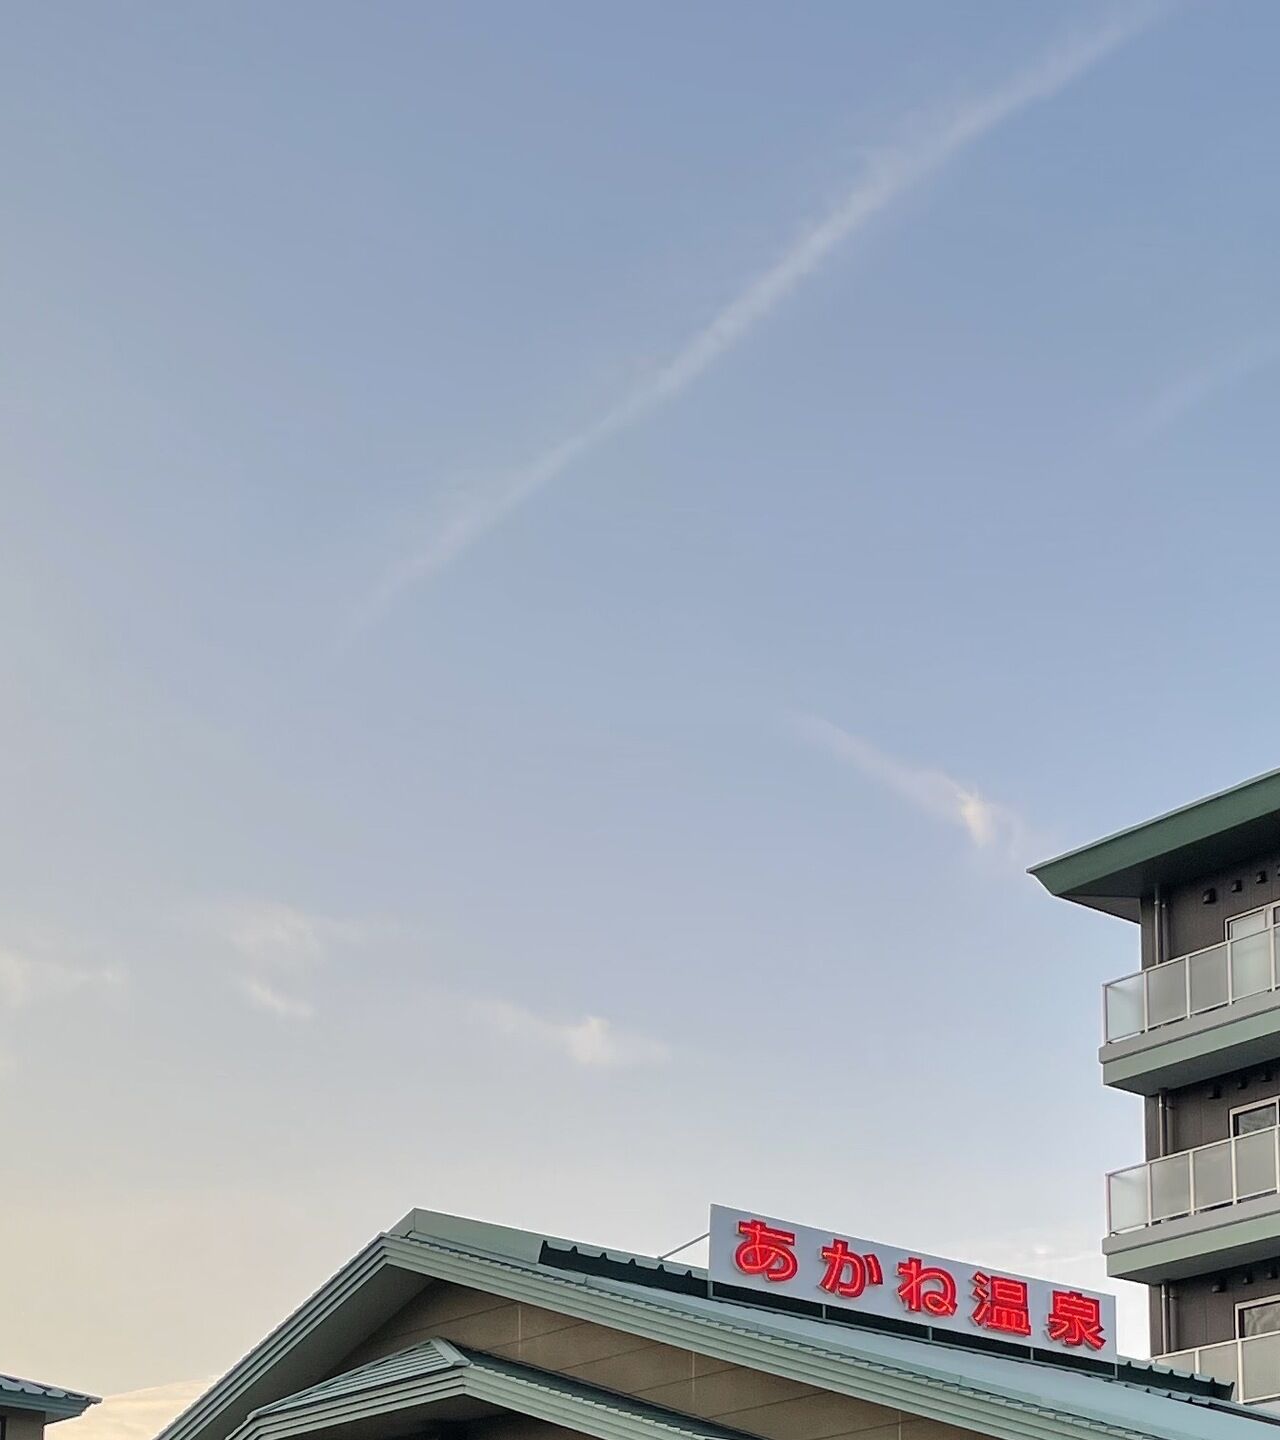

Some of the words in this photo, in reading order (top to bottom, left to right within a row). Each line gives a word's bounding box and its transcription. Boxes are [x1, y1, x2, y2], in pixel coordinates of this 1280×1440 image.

[734, 1218, 1107, 1351] あかね温泉
